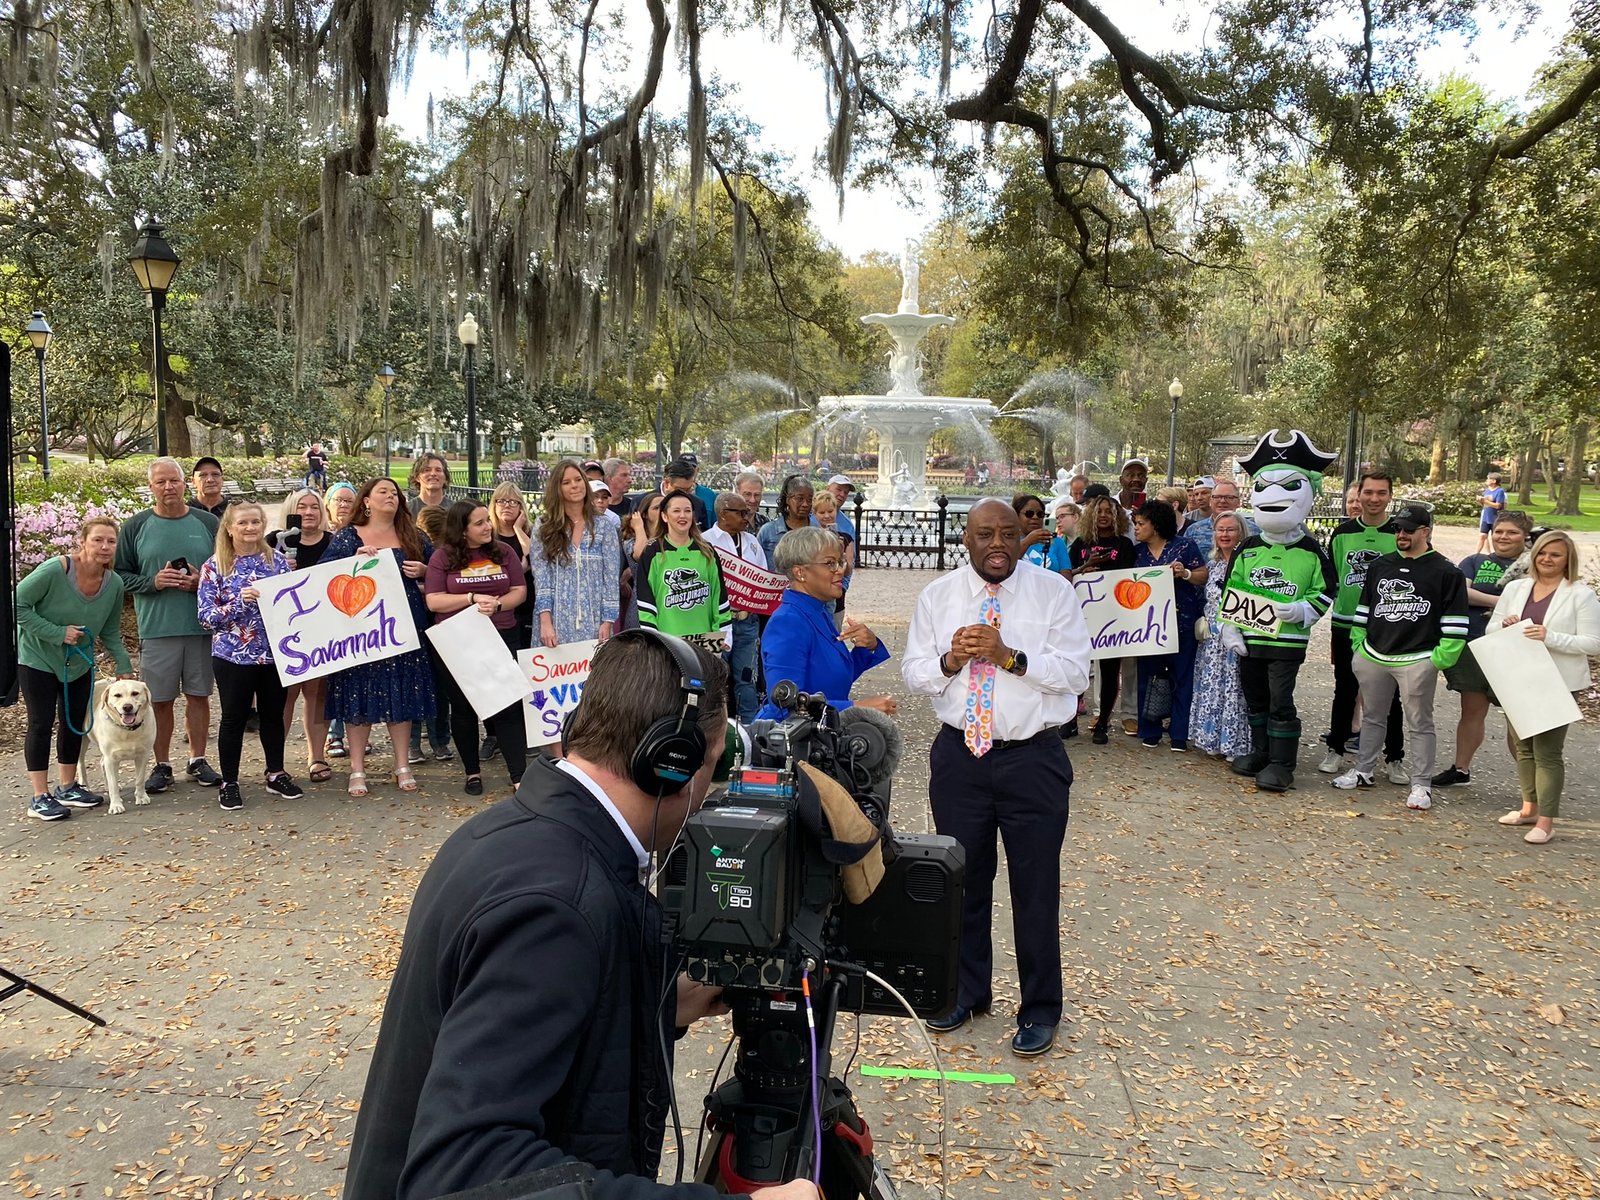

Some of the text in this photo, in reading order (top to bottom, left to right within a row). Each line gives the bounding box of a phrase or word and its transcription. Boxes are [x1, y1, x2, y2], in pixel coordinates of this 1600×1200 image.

[720, 554, 738, 572] nda
[455, 576, 491, 584] VIRGINIA
[273, 573, 320, 626] I
[753, 590, 779, 602] DISTRICT
[1074, 574, 1107, 610] I
[737, 596, 769, 610] Savannah
[1090, 599, 1171, 650] vannah!
[278, 598, 407, 676] Savannah
[541, 709, 567, 737] S
[668, 752, 688, 760] SONY
[729, 896, 752, 908] 90
